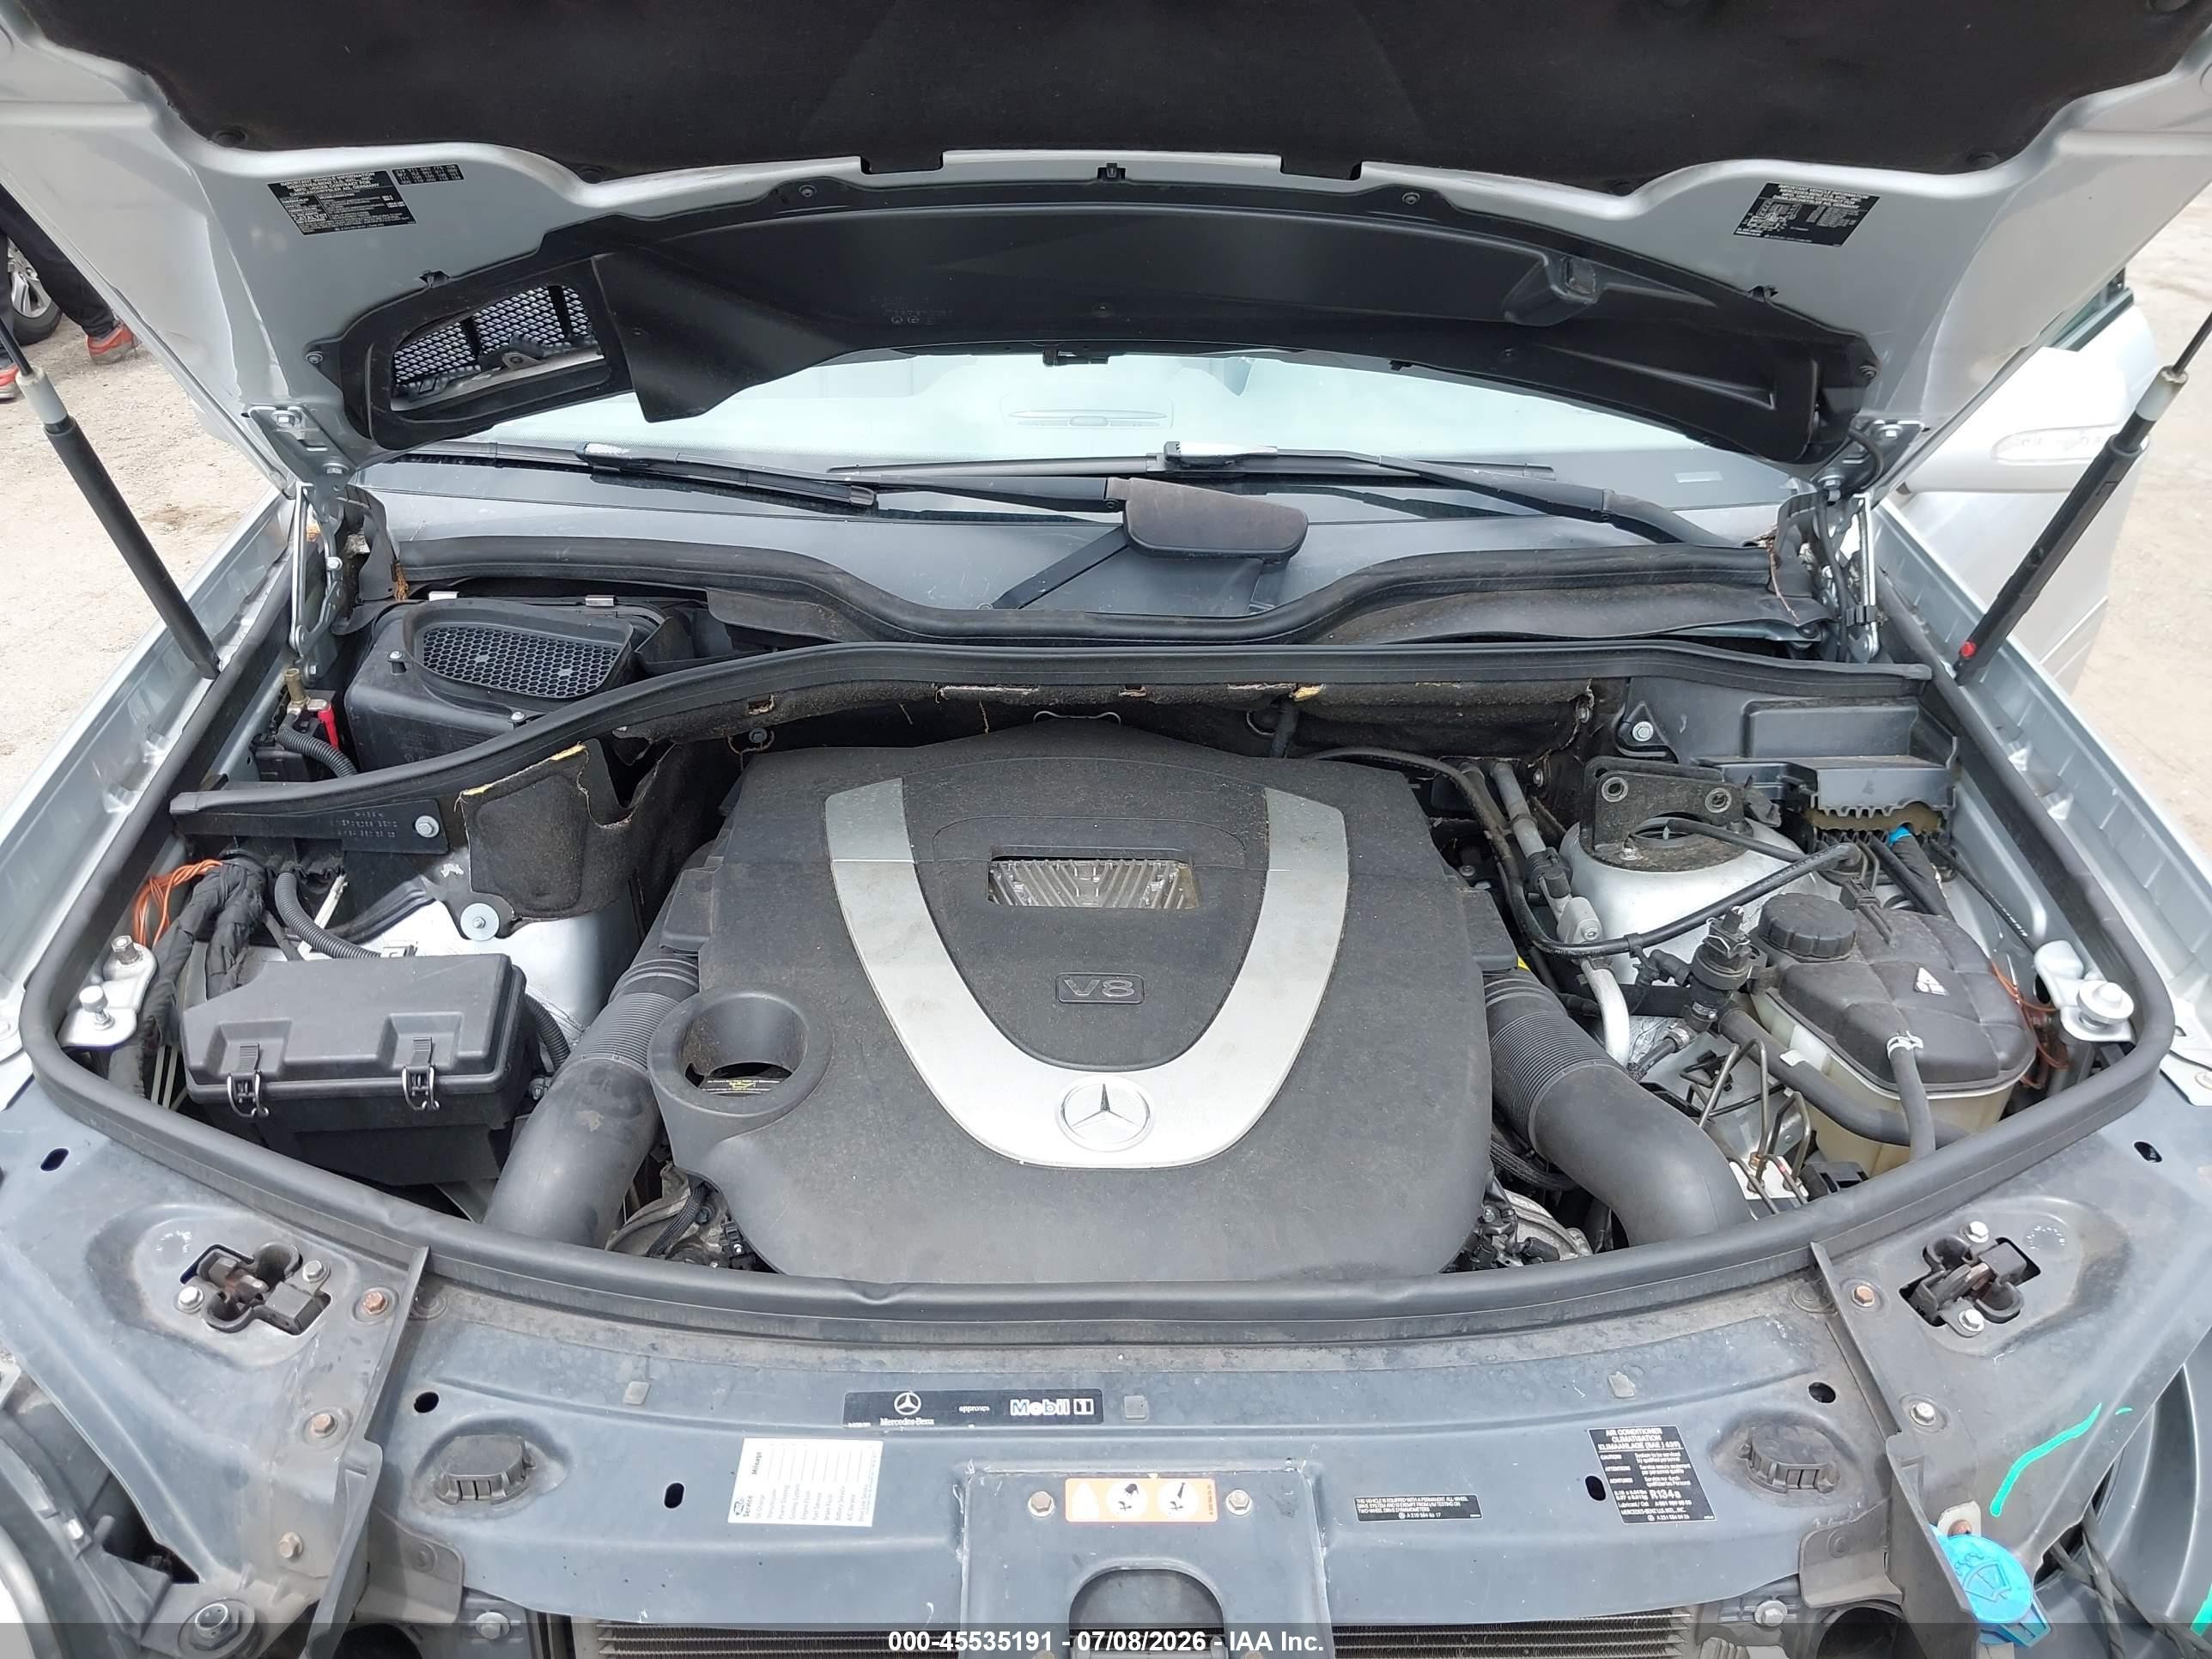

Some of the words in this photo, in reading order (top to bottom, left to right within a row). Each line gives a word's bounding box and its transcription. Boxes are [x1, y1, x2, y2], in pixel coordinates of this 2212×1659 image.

[1064, 978, 1135, 997] V8
[958, 1405, 989, 1413] approves
[1010, 1398, 1070, 1416] Mobil
[880, 1417, 934, 1426] Mercedes-Benz
[751, 1451, 762, 1475] Mileage
[1649, 1489, 1681, 1498] R134a
[744, 1495, 753, 1517] Service
